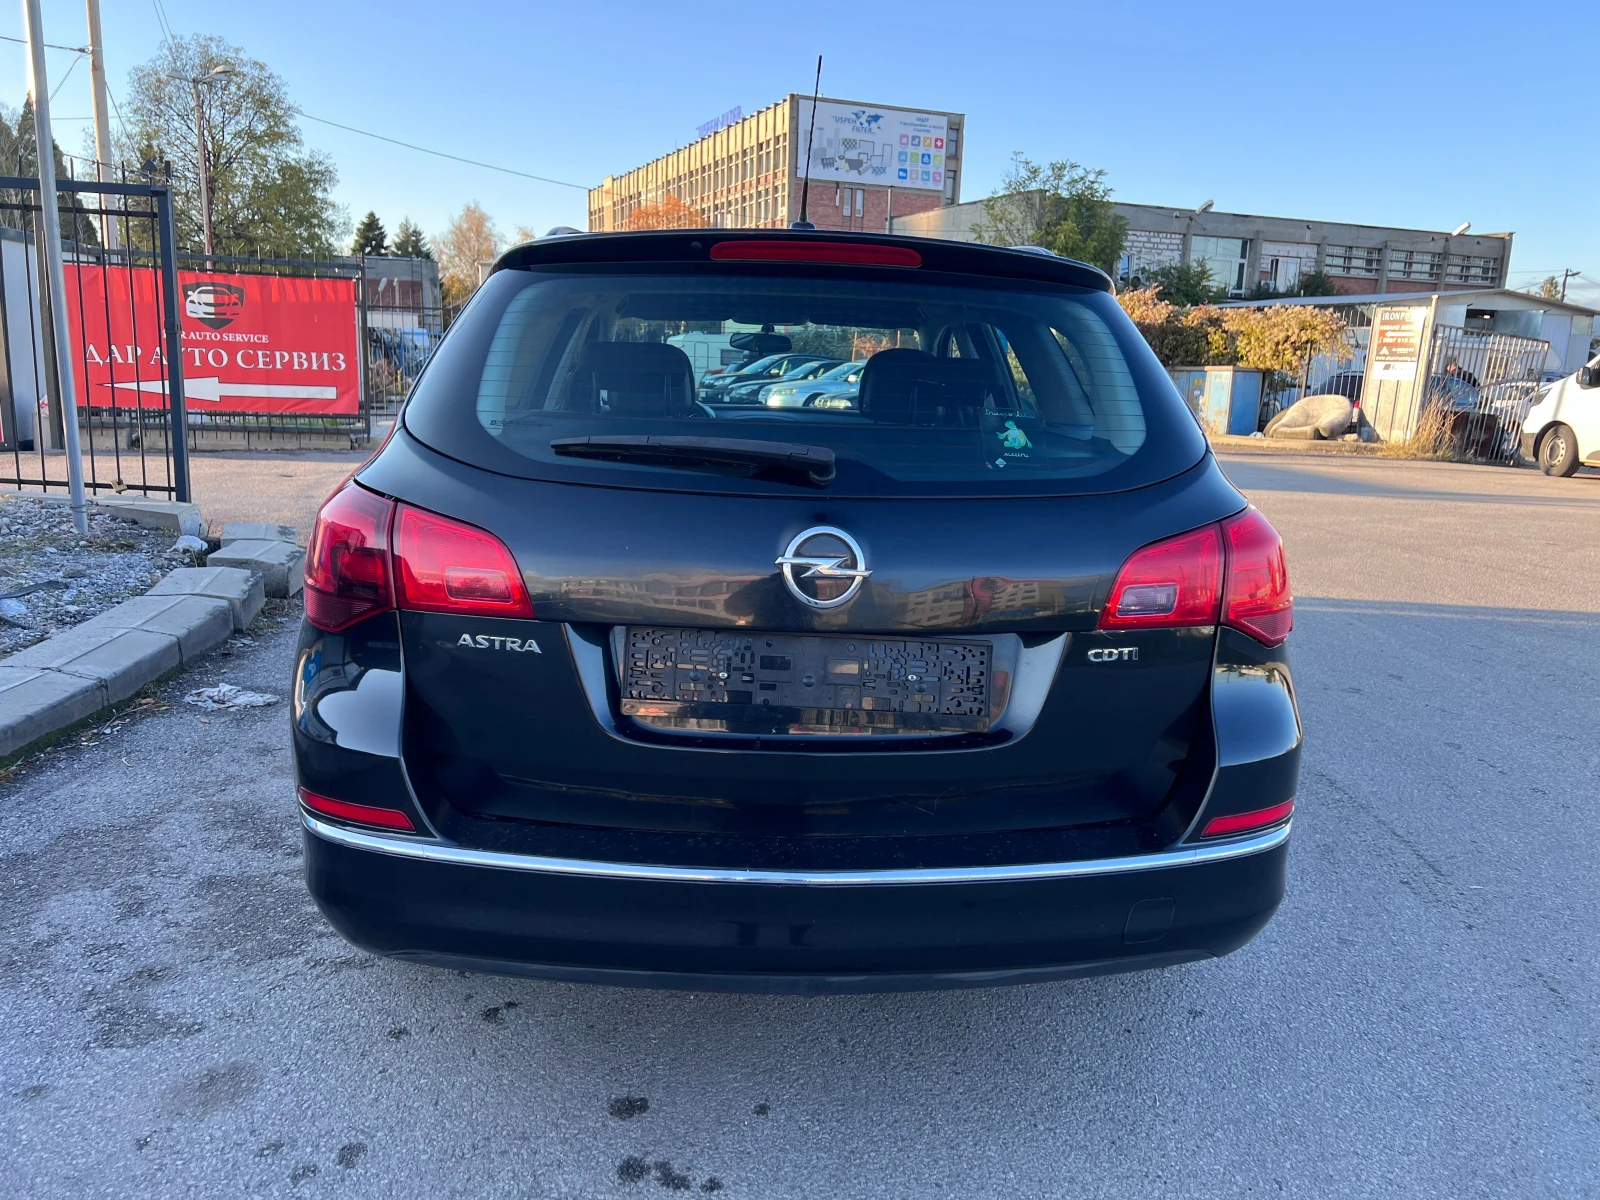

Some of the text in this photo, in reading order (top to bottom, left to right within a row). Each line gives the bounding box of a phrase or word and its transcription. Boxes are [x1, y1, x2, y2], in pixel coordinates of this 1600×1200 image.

[834, 116, 857, 124] USPEH
[851, 125, 873, 134] FILTER
[188, 331, 221, 341] AUTO
[222, 333, 269, 343] SERVICE
[85, 343, 346, 372] ДАР АТО СЕРВИЗ
[456, 633, 542, 654] ASTRA
